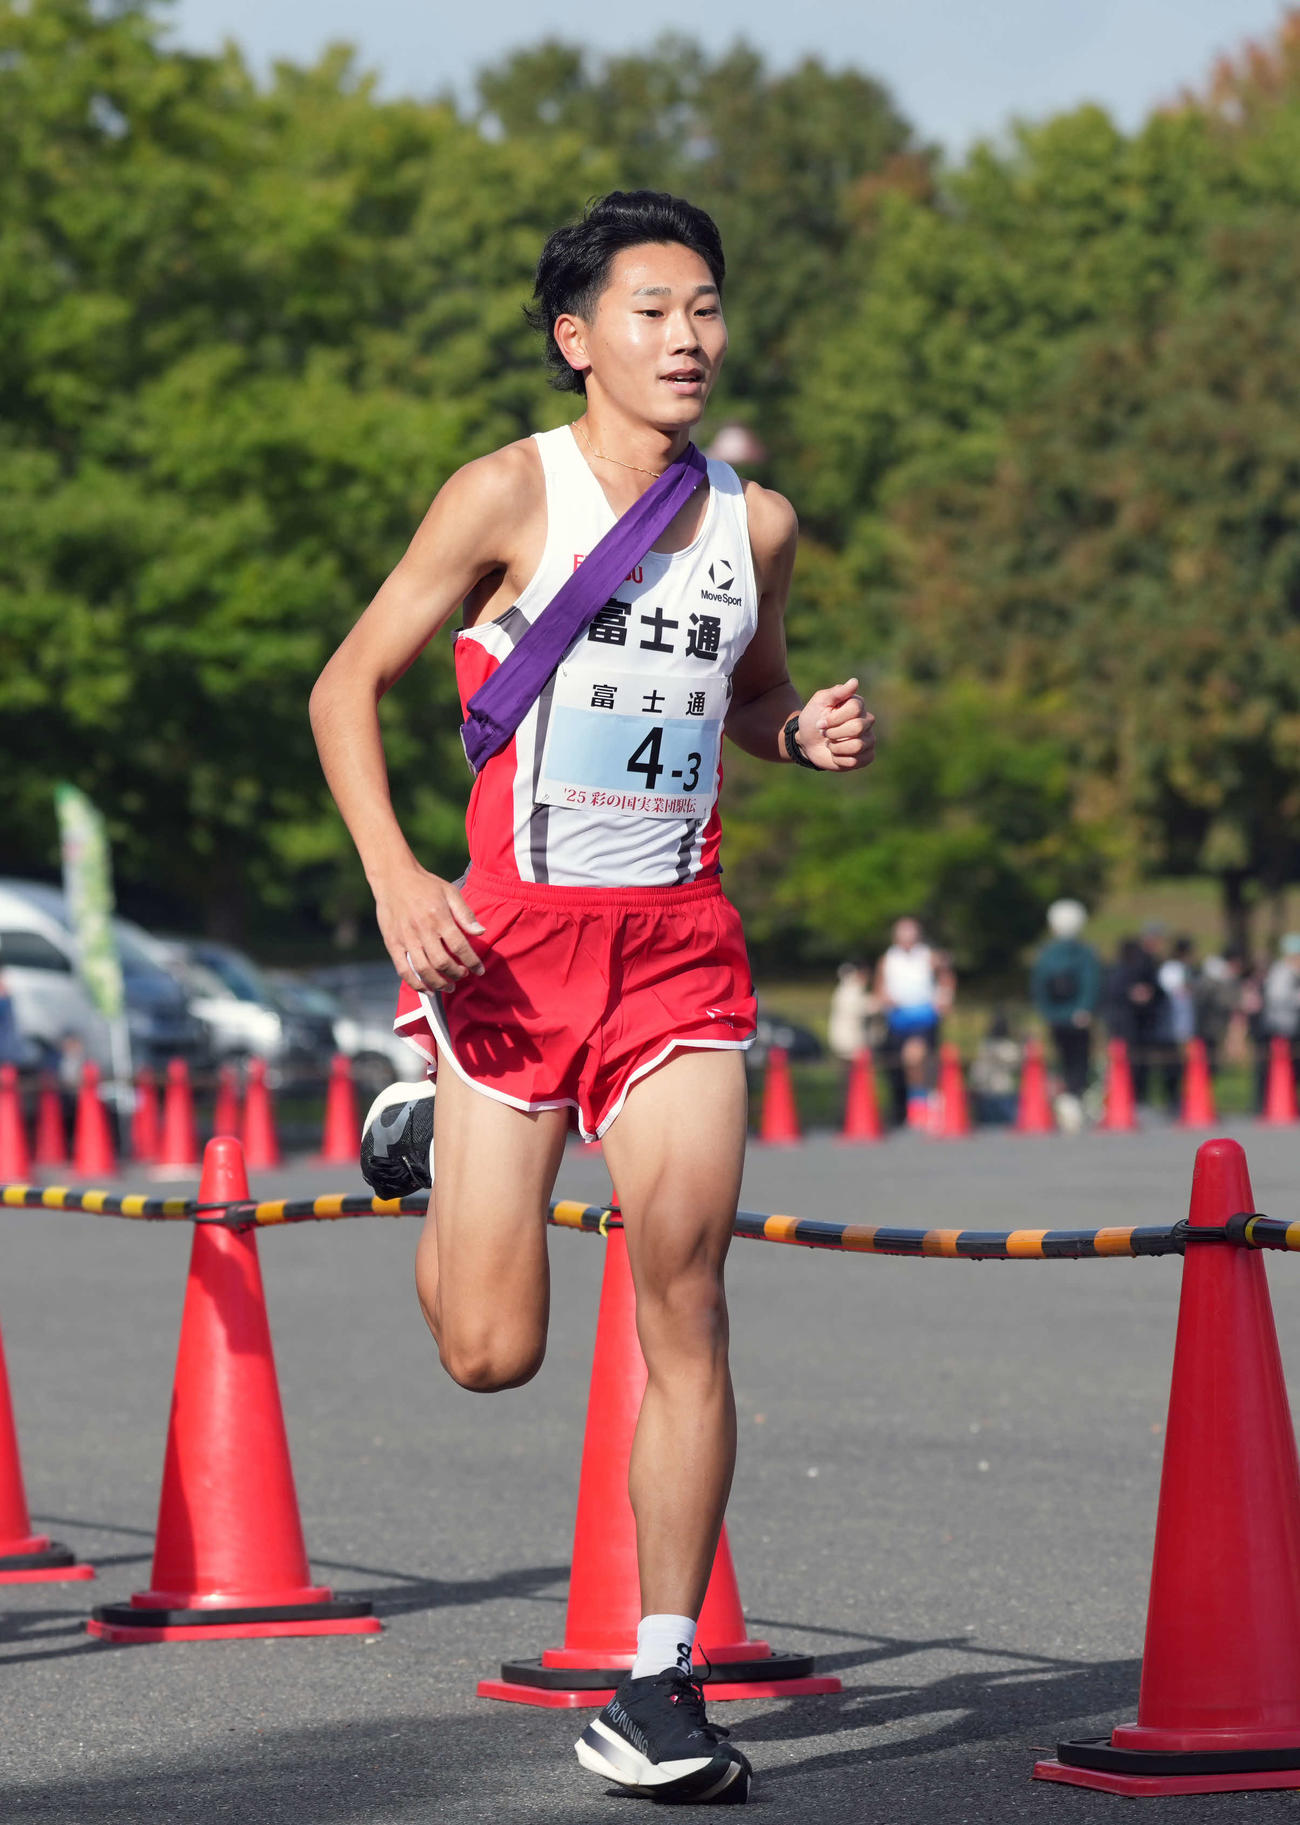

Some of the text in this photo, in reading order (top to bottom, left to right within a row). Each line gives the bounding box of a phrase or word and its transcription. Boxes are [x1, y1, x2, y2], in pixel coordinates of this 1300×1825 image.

[587, 597, 721, 661] 富士通
[590, 684, 706, 716] 富士通
[626, 726, 702, 792] 4-3
[591, 791, 697, 814] 彩の国実業団駅伝
